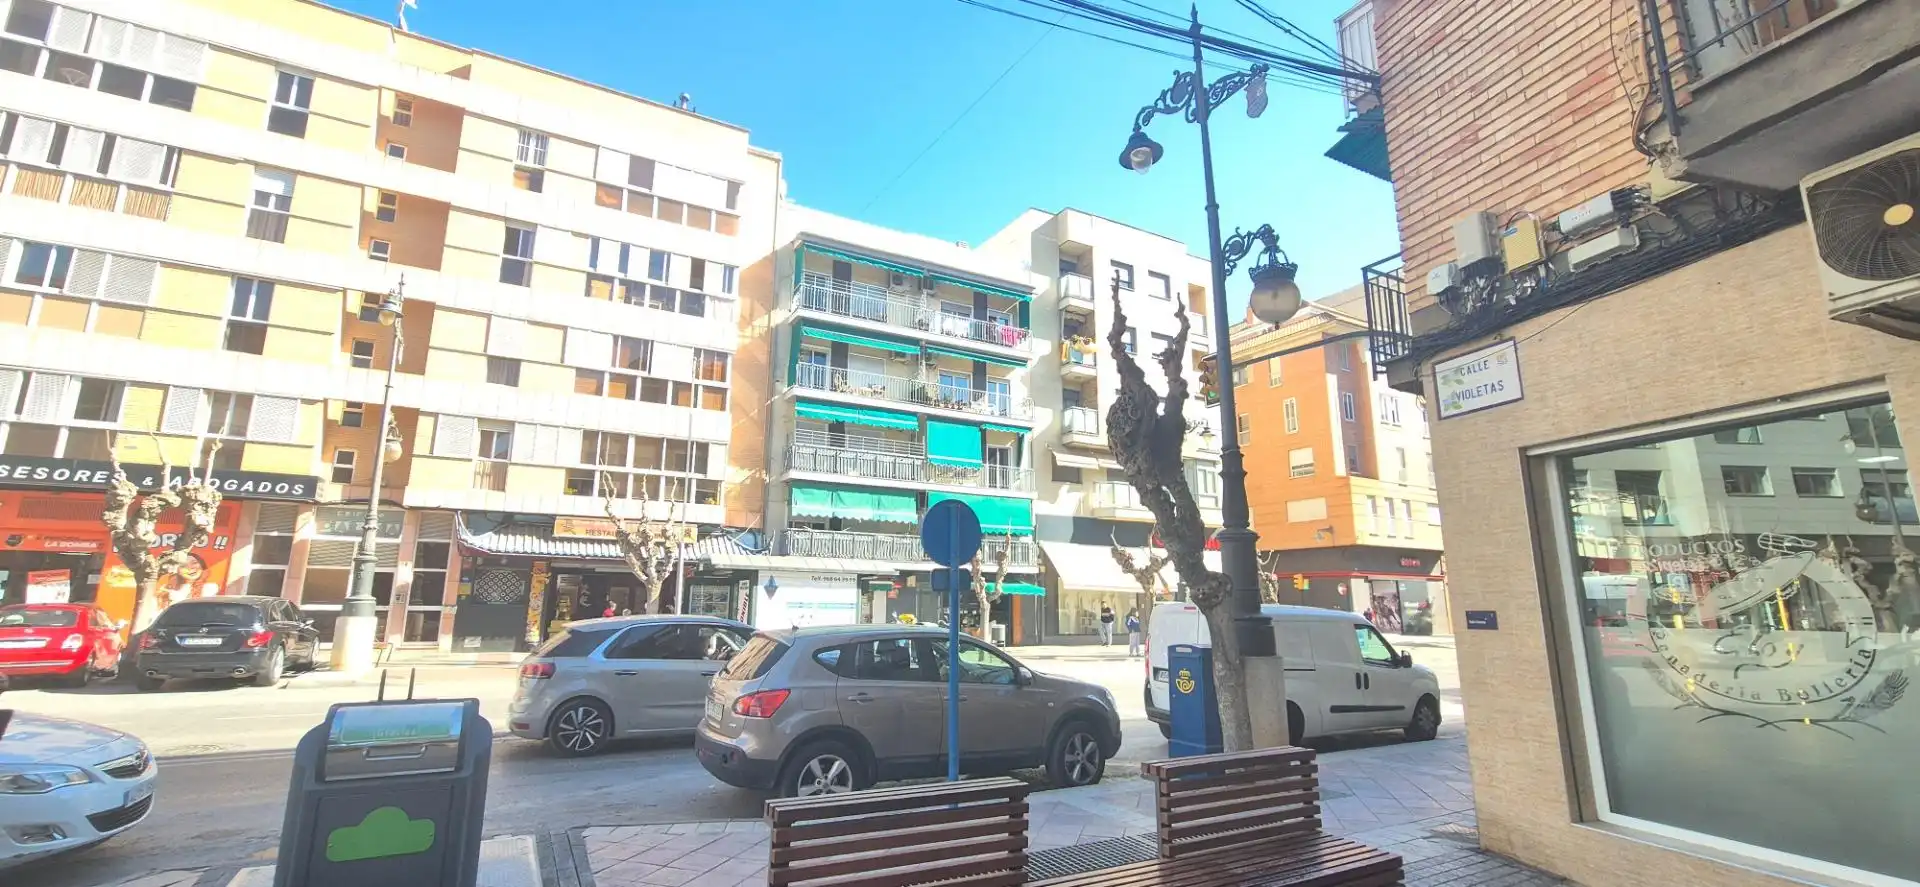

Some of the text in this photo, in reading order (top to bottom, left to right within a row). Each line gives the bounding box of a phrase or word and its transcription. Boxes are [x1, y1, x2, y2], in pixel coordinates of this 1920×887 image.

[1459, 360, 1489, 376] CALLE
[1455, 380, 1504, 401] VIOLETAS
[142, 476, 153, 486] &
[169, 475, 305, 495] ABOGADOS
